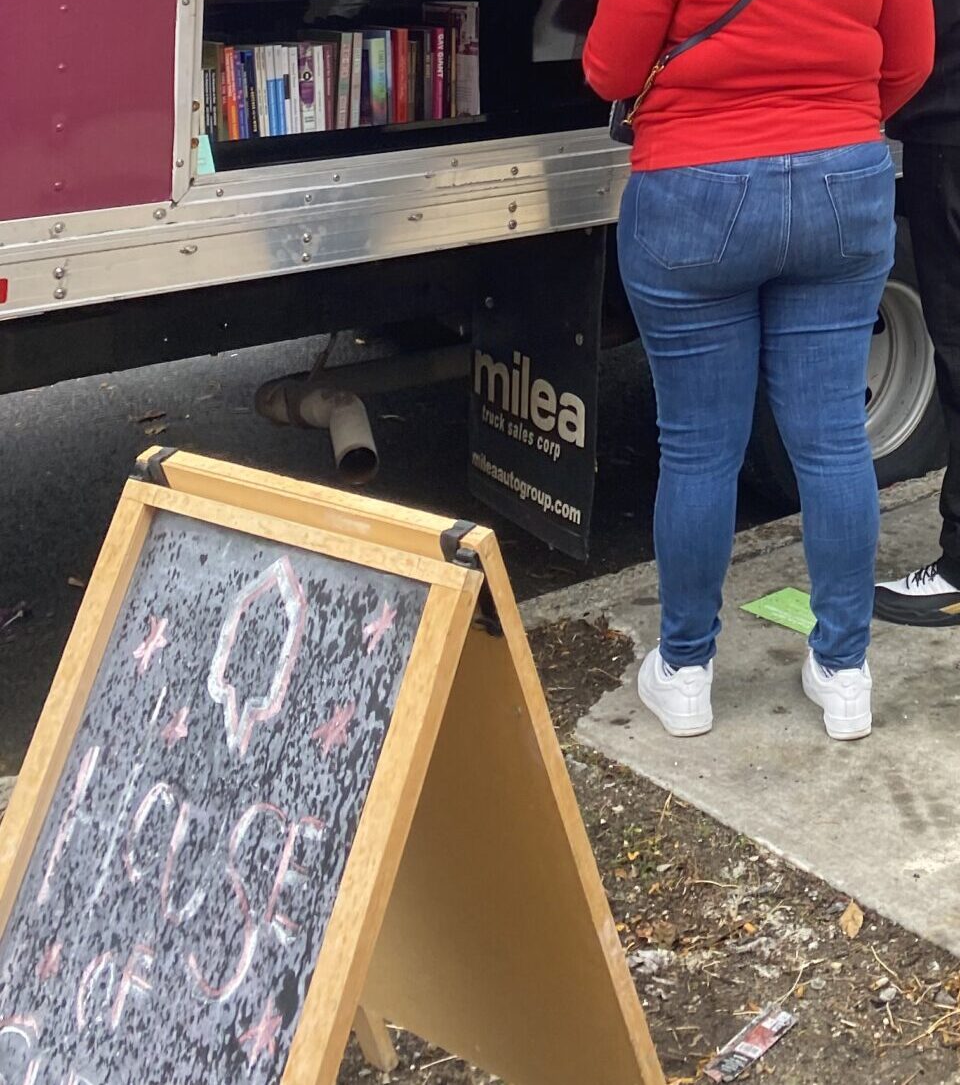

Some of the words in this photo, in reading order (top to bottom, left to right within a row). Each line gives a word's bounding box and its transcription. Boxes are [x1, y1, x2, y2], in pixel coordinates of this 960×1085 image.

[474, 349, 586, 448] milea
[482, 404, 505, 432] truck
[507, 420, 534, 446] sales
[537, 435, 561, 462] corp
[472, 451, 581, 525] mileaautogroup.com
